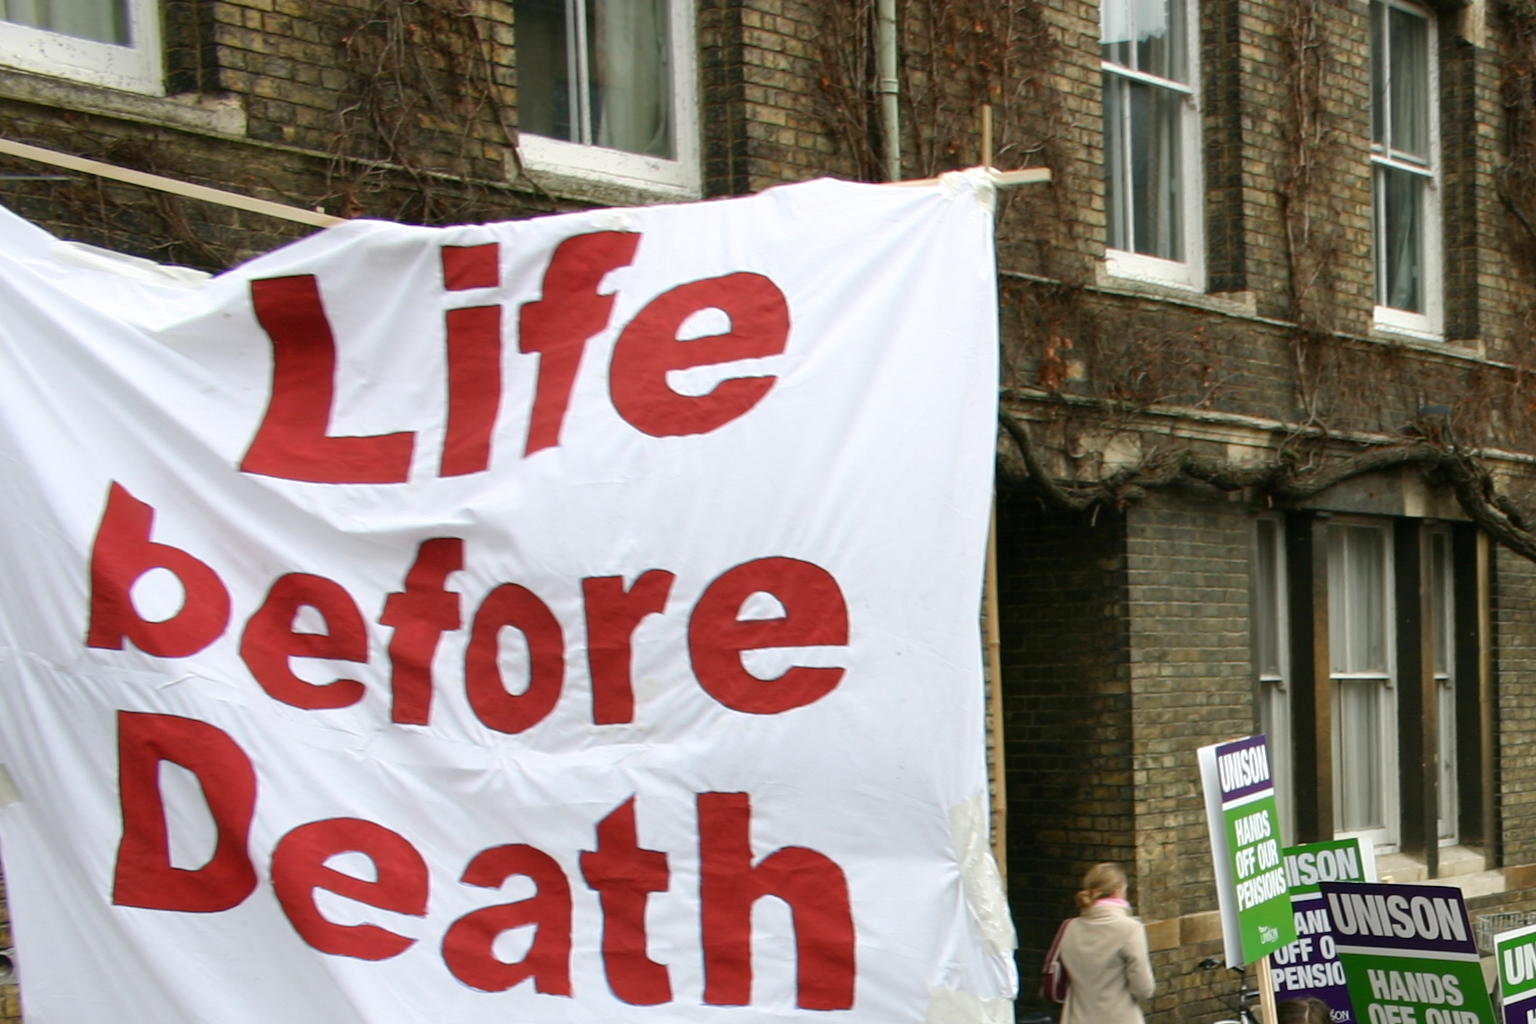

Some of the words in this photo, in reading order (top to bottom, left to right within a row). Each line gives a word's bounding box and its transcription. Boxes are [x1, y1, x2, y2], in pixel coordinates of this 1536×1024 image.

[239, 231, 791, 484] Life
[86, 480, 849, 734] before
[1218, 745, 1270, 793] UNISON
[1235, 810, 1271, 847] HANDS
[112, 710, 856, 1011] Death
[1236, 848, 1256, 880] OFF
[1257, 839, 1279, 870] OUR
[1284, 847, 1360, 887] ISON
[1236, 867, 1286, 912] PENSIONS
[1327, 892, 1467, 942] UNISON
[1274, 937, 1313, 966] OFF
[1271, 961, 1347, 992] PENSIO
[1367, 968, 1464, 1006] HANDS
